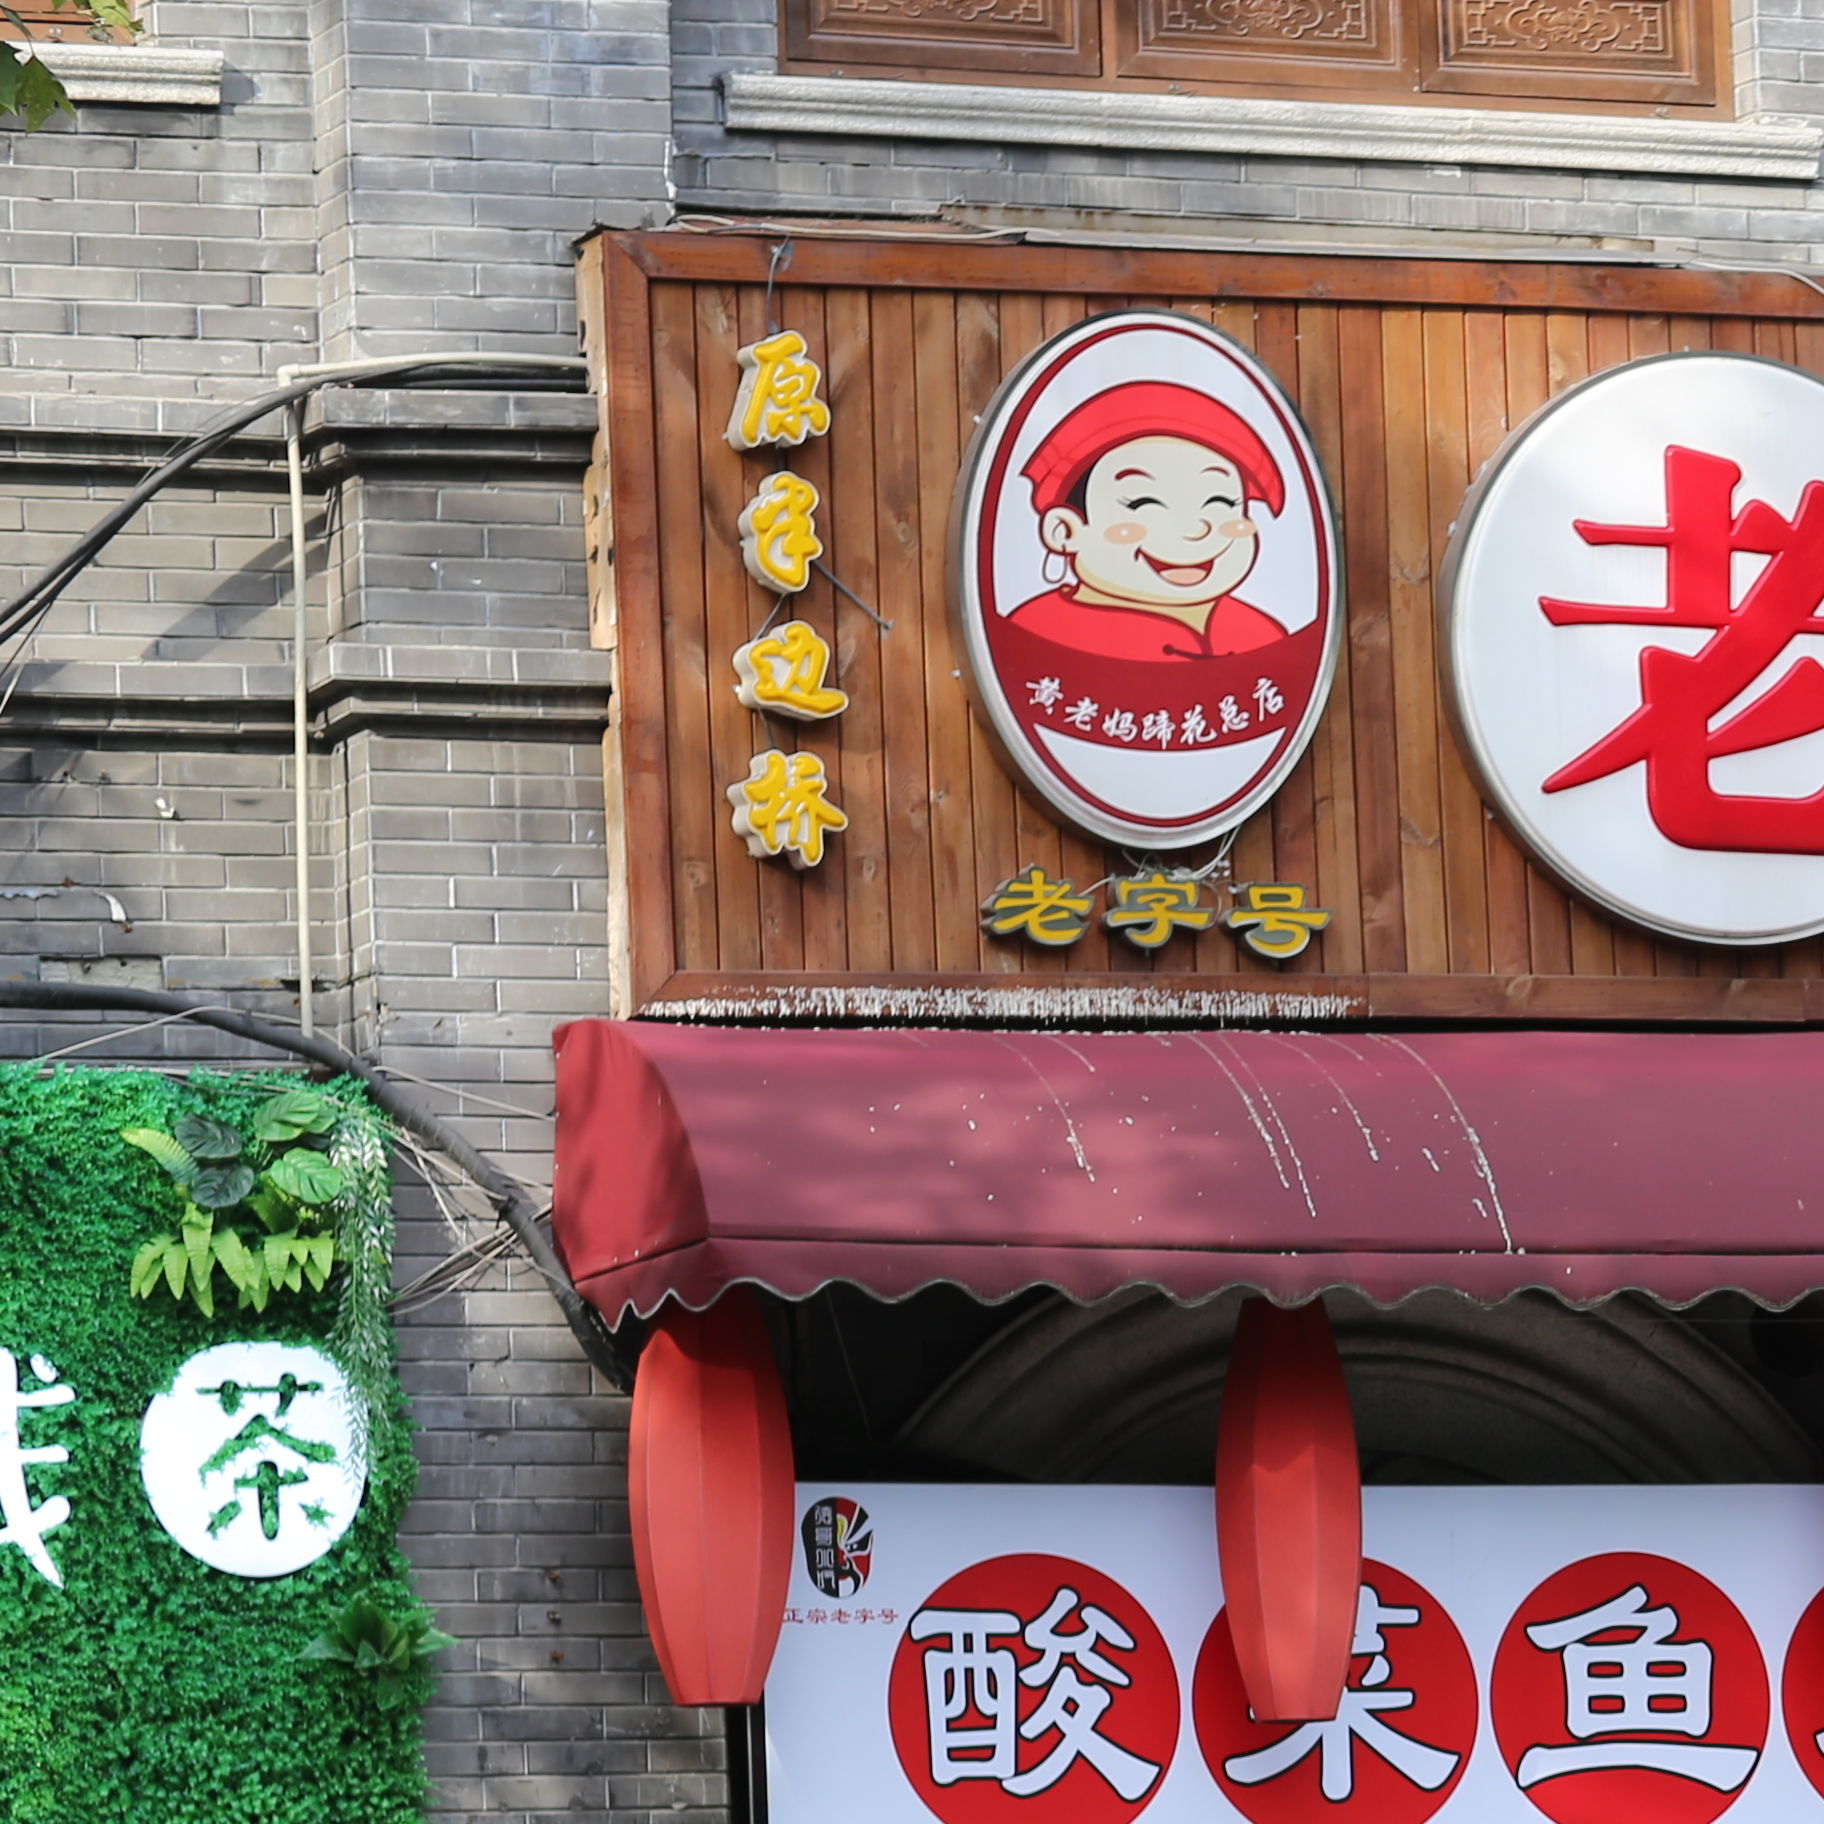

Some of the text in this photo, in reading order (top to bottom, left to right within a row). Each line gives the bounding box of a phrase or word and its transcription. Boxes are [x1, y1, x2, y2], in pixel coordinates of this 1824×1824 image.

[1025, 676, 1286, 751] 黄老妈蹄花总店
[988, 867, 1333, 958] 老字号
[782, 1608, 899, 1625] 正宗老字号
